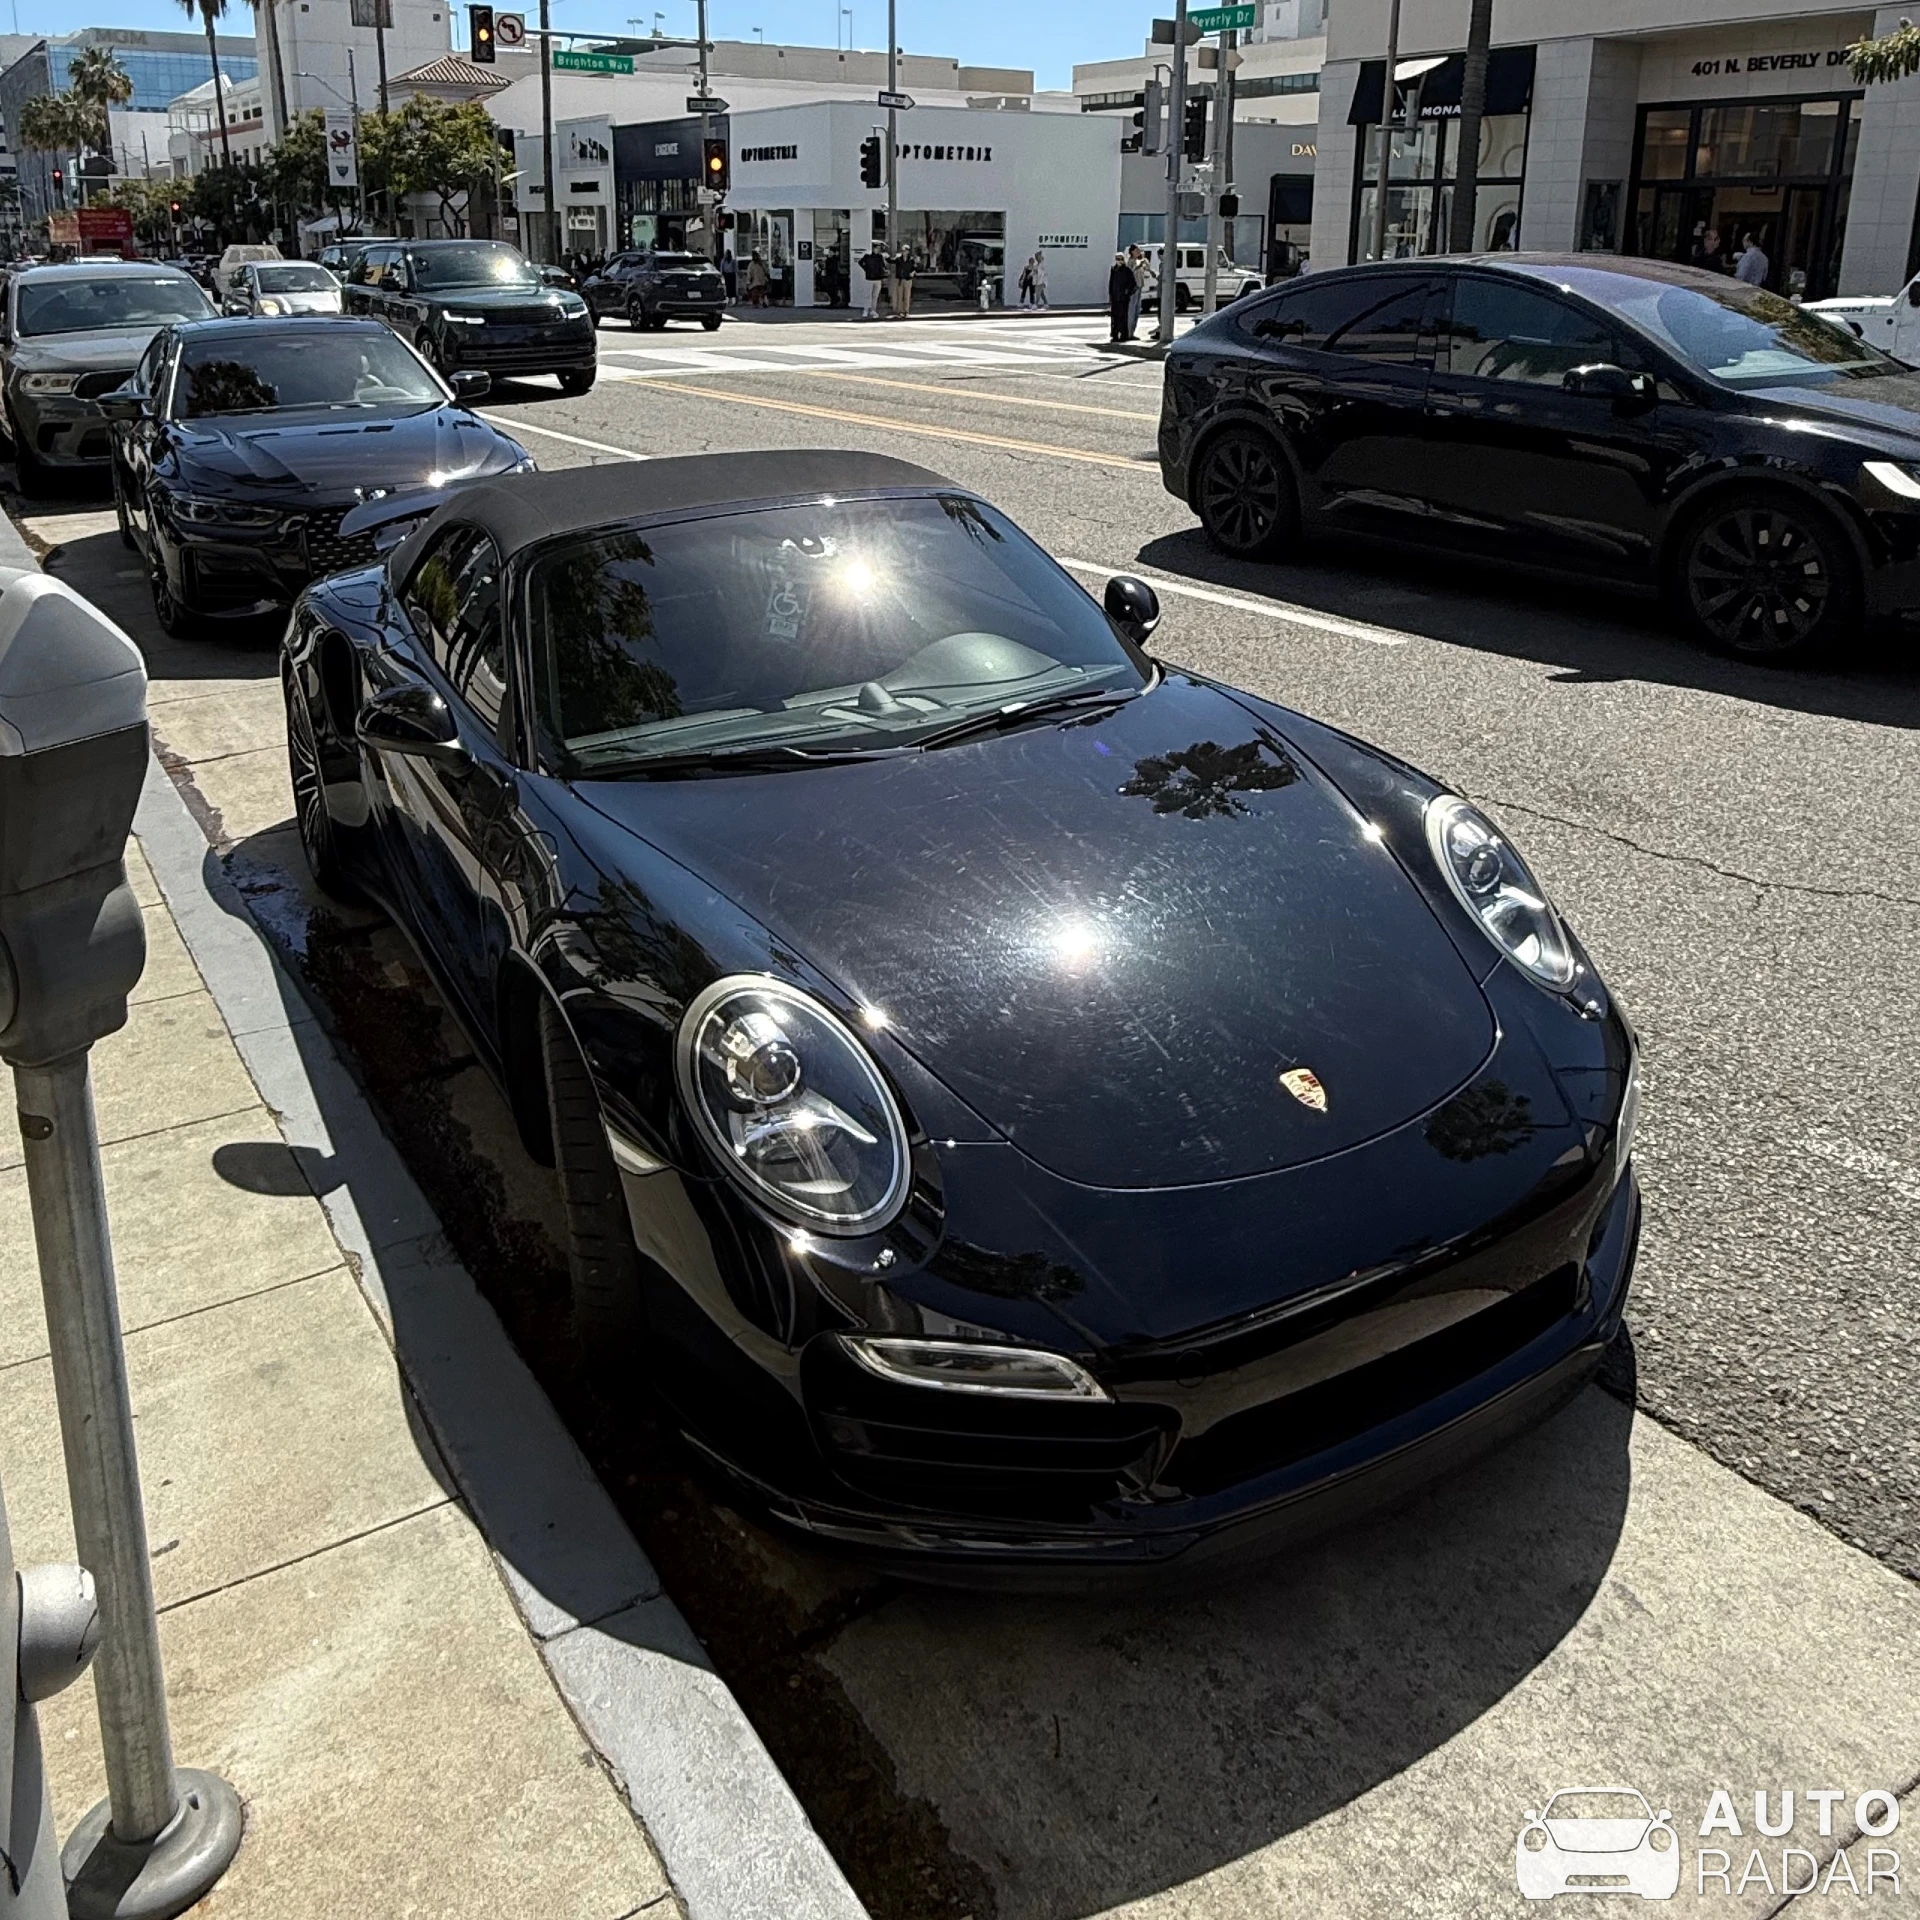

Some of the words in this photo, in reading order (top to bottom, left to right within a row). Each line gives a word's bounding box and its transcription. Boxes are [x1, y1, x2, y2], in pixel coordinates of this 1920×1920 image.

[1191, 13, 1231, 27] Beverly
[1236, 10, 1250, 23] Dr
[557, 55, 604, 69] Brighton
[608, 58, 629, 71] Way
[1691, 60, 1720, 76] 401
[1725, 58, 1740, 73] N.
[1747, 52, 1820, 72] BEVERLY
[741, 144, 798, 162] OPTOMETRIX
